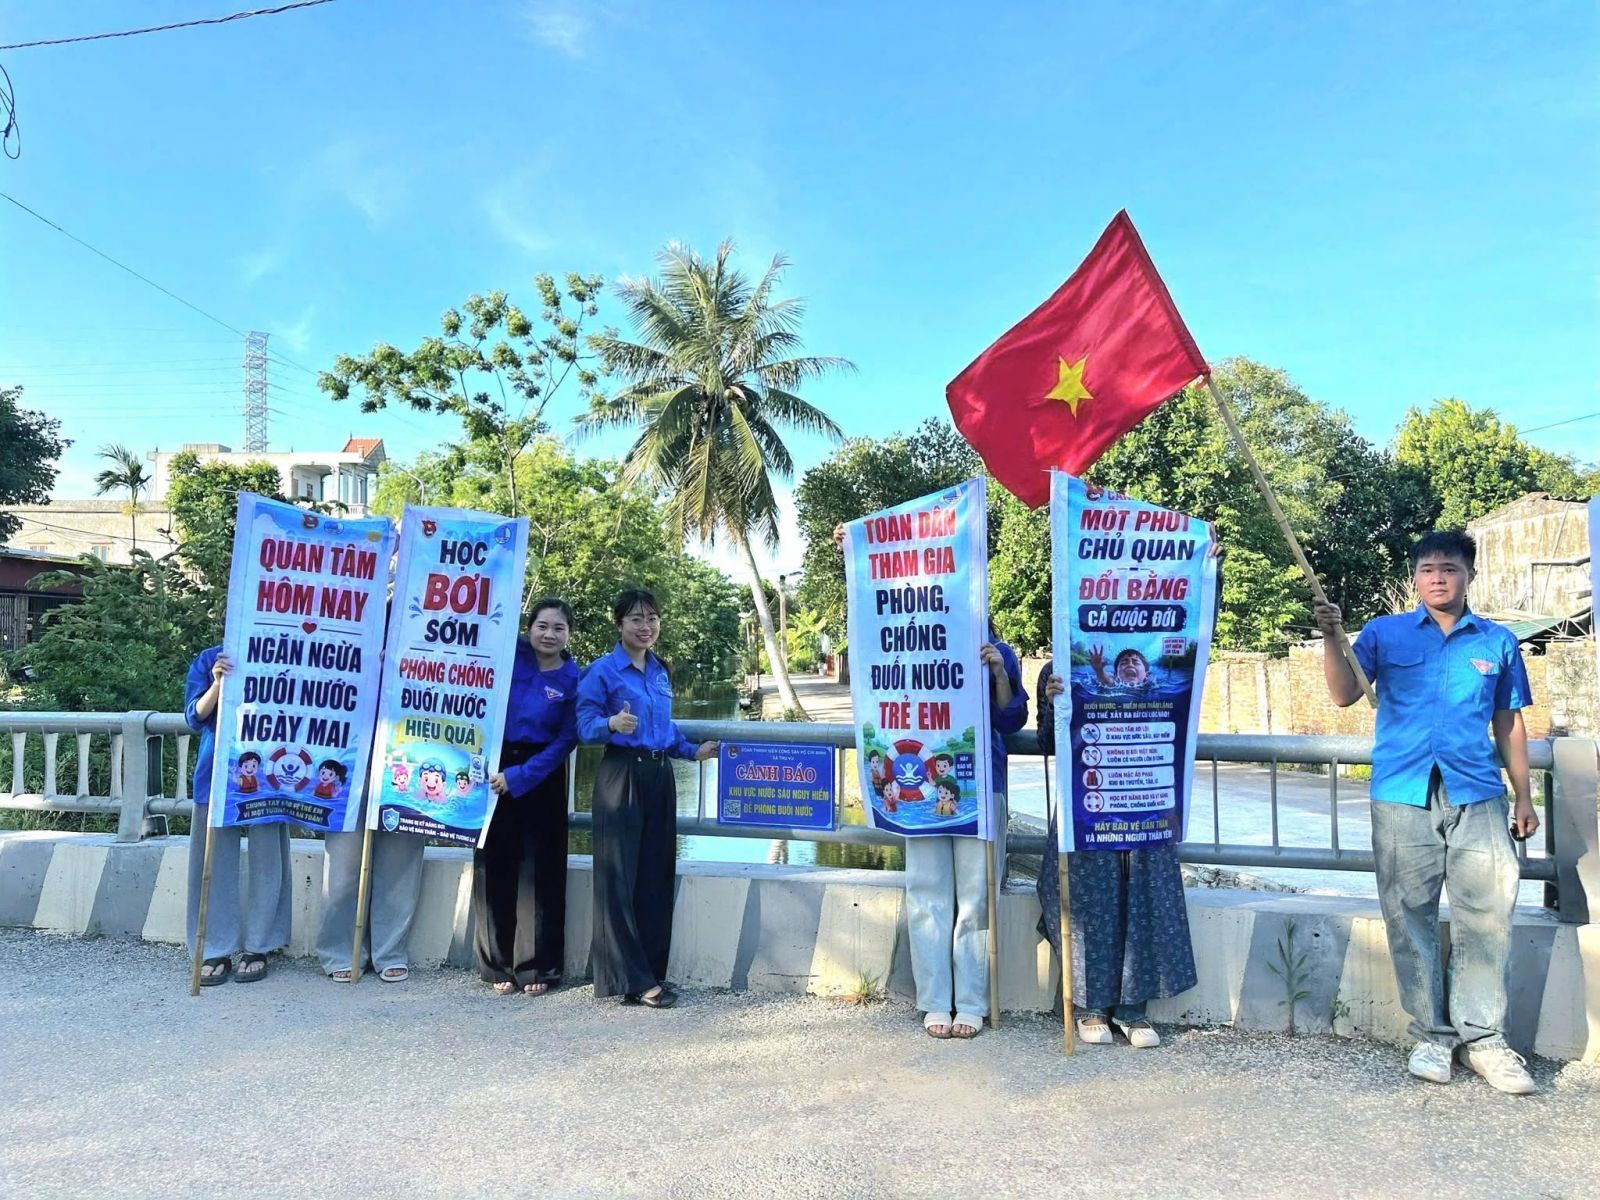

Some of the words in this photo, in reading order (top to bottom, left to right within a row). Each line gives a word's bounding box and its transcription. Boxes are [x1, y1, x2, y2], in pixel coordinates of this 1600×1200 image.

[864, 512, 912, 544] TOÀN
[918, 505, 956, 539] DÂN
[1080, 506, 1130, 535] MỘT
[260, 539, 324, 573] QUAN
[330, 543, 377, 580] TÂM
[440, 540, 488, 571] HỌC
[869, 550, 918, 579] THAM
[924, 546, 955, 574] GIA
[1078, 532, 1125, 560] CHỦ
[1131, 539, 1195, 563] QUAN
[256, 576, 314, 615] HÔM
[320, 587, 368, 622] NAY
[423, 573, 490, 616] BƠI
[876, 582, 950, 615] PHÒNG,
[1079, 570, 1119, 600] ĐỔI
[1127, 571, 1188, 600] BẰNG
[424, 616, 479, 646] SỚM
[1088, 604, 1107, 627] CẢ
[1112, 607, 1147, 631] CUỘC
[1152, 607, 1176, 627] ĐỜI
[880, 617, 947, 652] CHỐNG
[247, 633, 304, 666] NGĂN
[308, 639, 362, 673] NGỪA
[399, 656, 446, 683] PHÒNG
[448, 660, 494, 689] CHỐNG
[871, 656, 905, 690] ĐUỐI
[912, 658, 964, 690] NƯỚC
[244, 669, 296, 704] ĐUỐI
[300, 678, 357, 711] NƯỚC
[401, 686, 438, 712] ĐUỐI
[441, 692, 487, 719] NƯỚC
[879, 695, 910, 730] TRẺ
[919, 702, 950, 730] EM
[241, 710, 303, 743] NGÀY
[307, 718, 350, 749] MAI
[405, 718, 440, 742] HIỆU
[444, 724, 475, 746] QUẢ
[736, 760, 779, 781] CẢNH
[783, 762, 816, 783] BÁO
[729, 787, 741, 796] KHU
[744, 787, 756, 799] VỰC
[758, 787, 775, 798] NƯỚC
[778, 788, 790, 798] SÂU
[793, 790, 810, 800] NGUY
[812, 787, 828, 800] HIỂM
[754, 802, 775, 814] PHÒNG
[795, 804, 813, 816] NƯỚC
[1086, 833, 1095, 843] VÀ
[1097, 832, 1123, 842] NHỮNG
[1125, 832, 1147, 842] NGƯỜI
